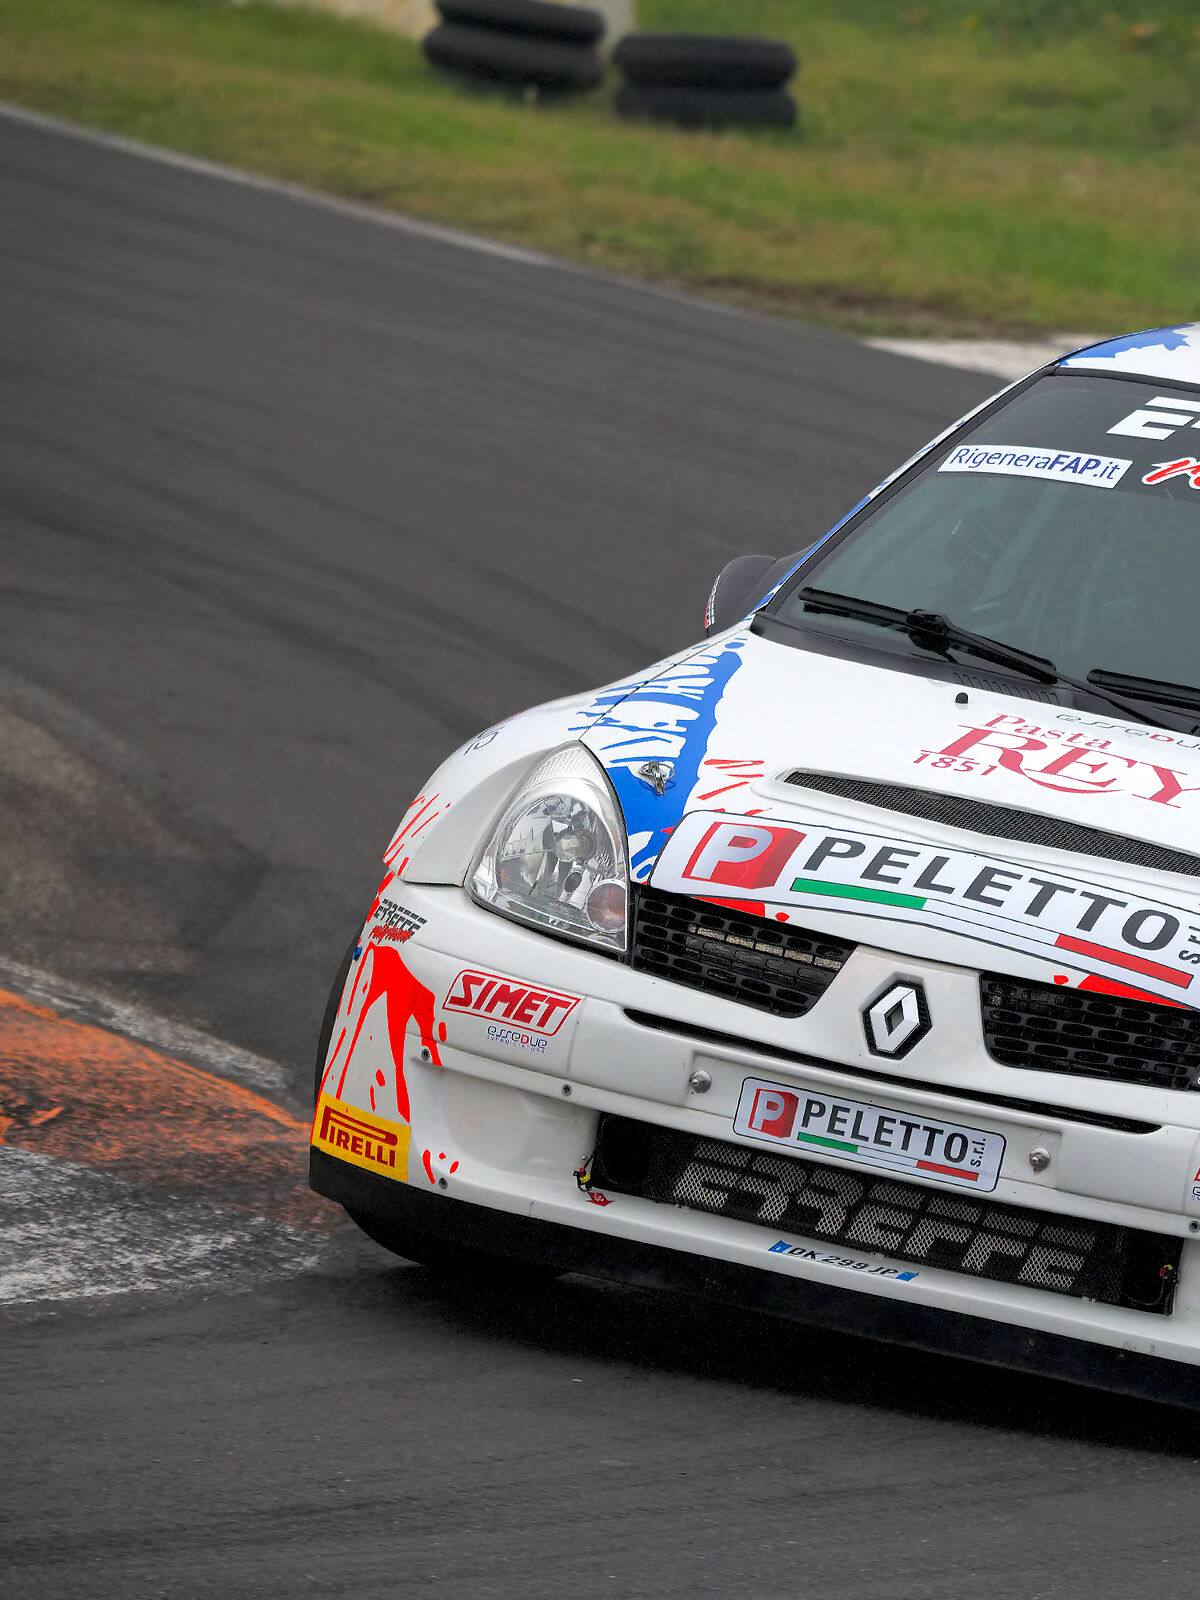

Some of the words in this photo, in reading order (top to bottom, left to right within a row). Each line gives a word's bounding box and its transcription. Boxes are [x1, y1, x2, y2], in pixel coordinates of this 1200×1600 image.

[950, 446, 1121, 481] RigeneraFAP.it
[981, 712, 1113, 752] Pasta
[912, 753, 998, 778] 1851
[802, 835, 1180, 952] PELETTO
[451, 972, 572, 1031] SIMET
[319, 1106, 398, 1168] PIRELLI
[801, 1099, 969, 1164] PELETTO
[970, 1138, 988, 1168] s.r.l.
[673, 1144, 1095, 1289] ERREFFE
[822, 1255, 870, 1270] 299
[869, 1266, 899, 1278] JP
